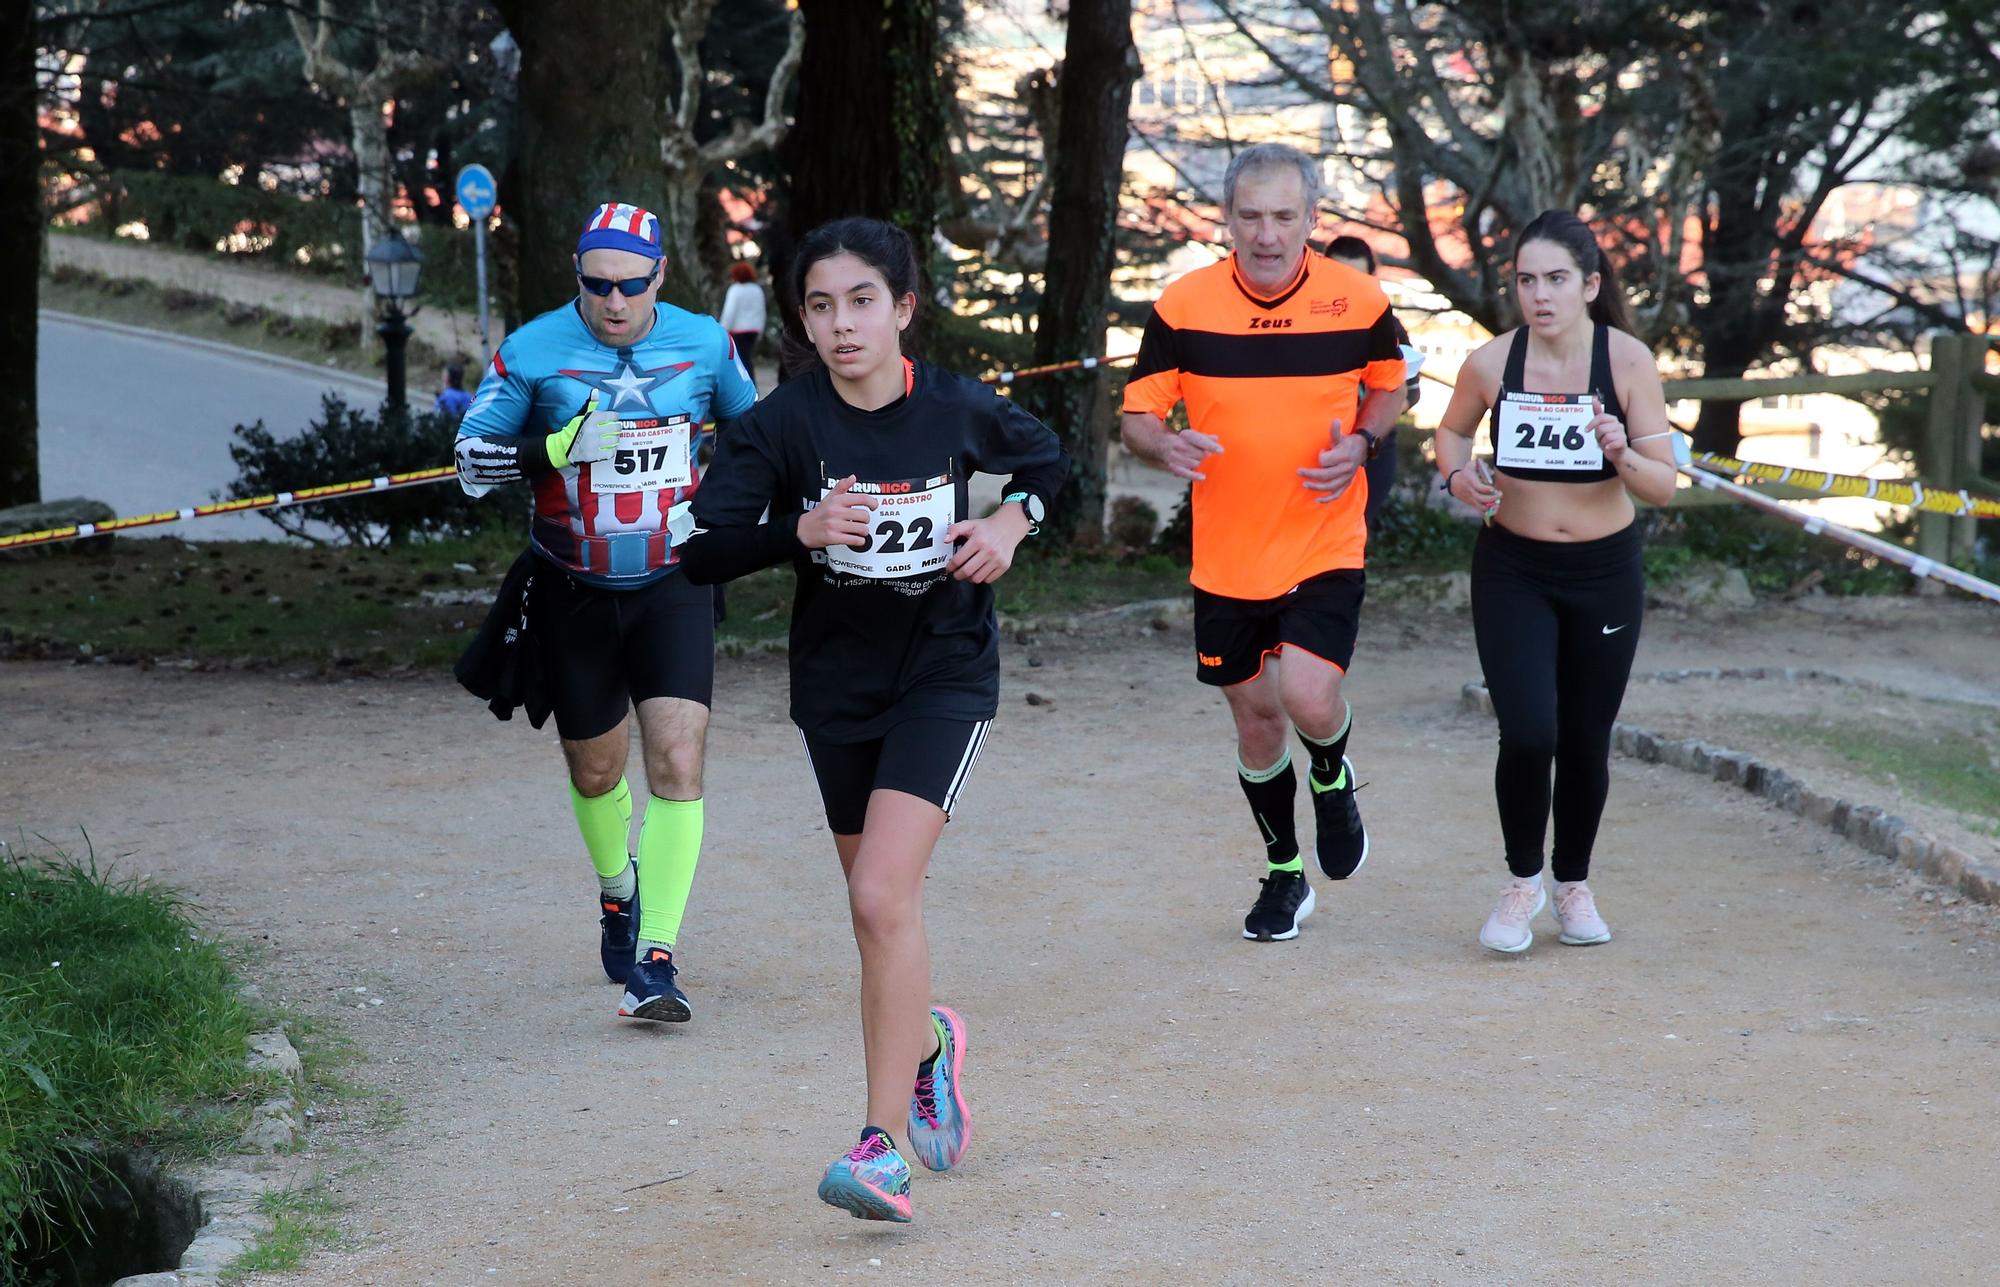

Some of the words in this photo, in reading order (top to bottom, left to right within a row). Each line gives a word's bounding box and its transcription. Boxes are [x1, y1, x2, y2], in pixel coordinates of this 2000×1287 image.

[1248, 317, 1293, 329] Zeus
[1519, 404, 1542, 412] SUBIDA
[637, 430, 647, 438] AO
[648, 428, 673, 436] CASTRO
[1515, 422, 1585, 451] 246
[614, 445, 669, 475] 517
[664, 476, 685, 484] MRW
[881, 498, 895, 507] AO
[896, 494, 933, 506] CASTRO
[885, 563, 912, 573] GADIS
[921, 553, 948, 568] MRW
